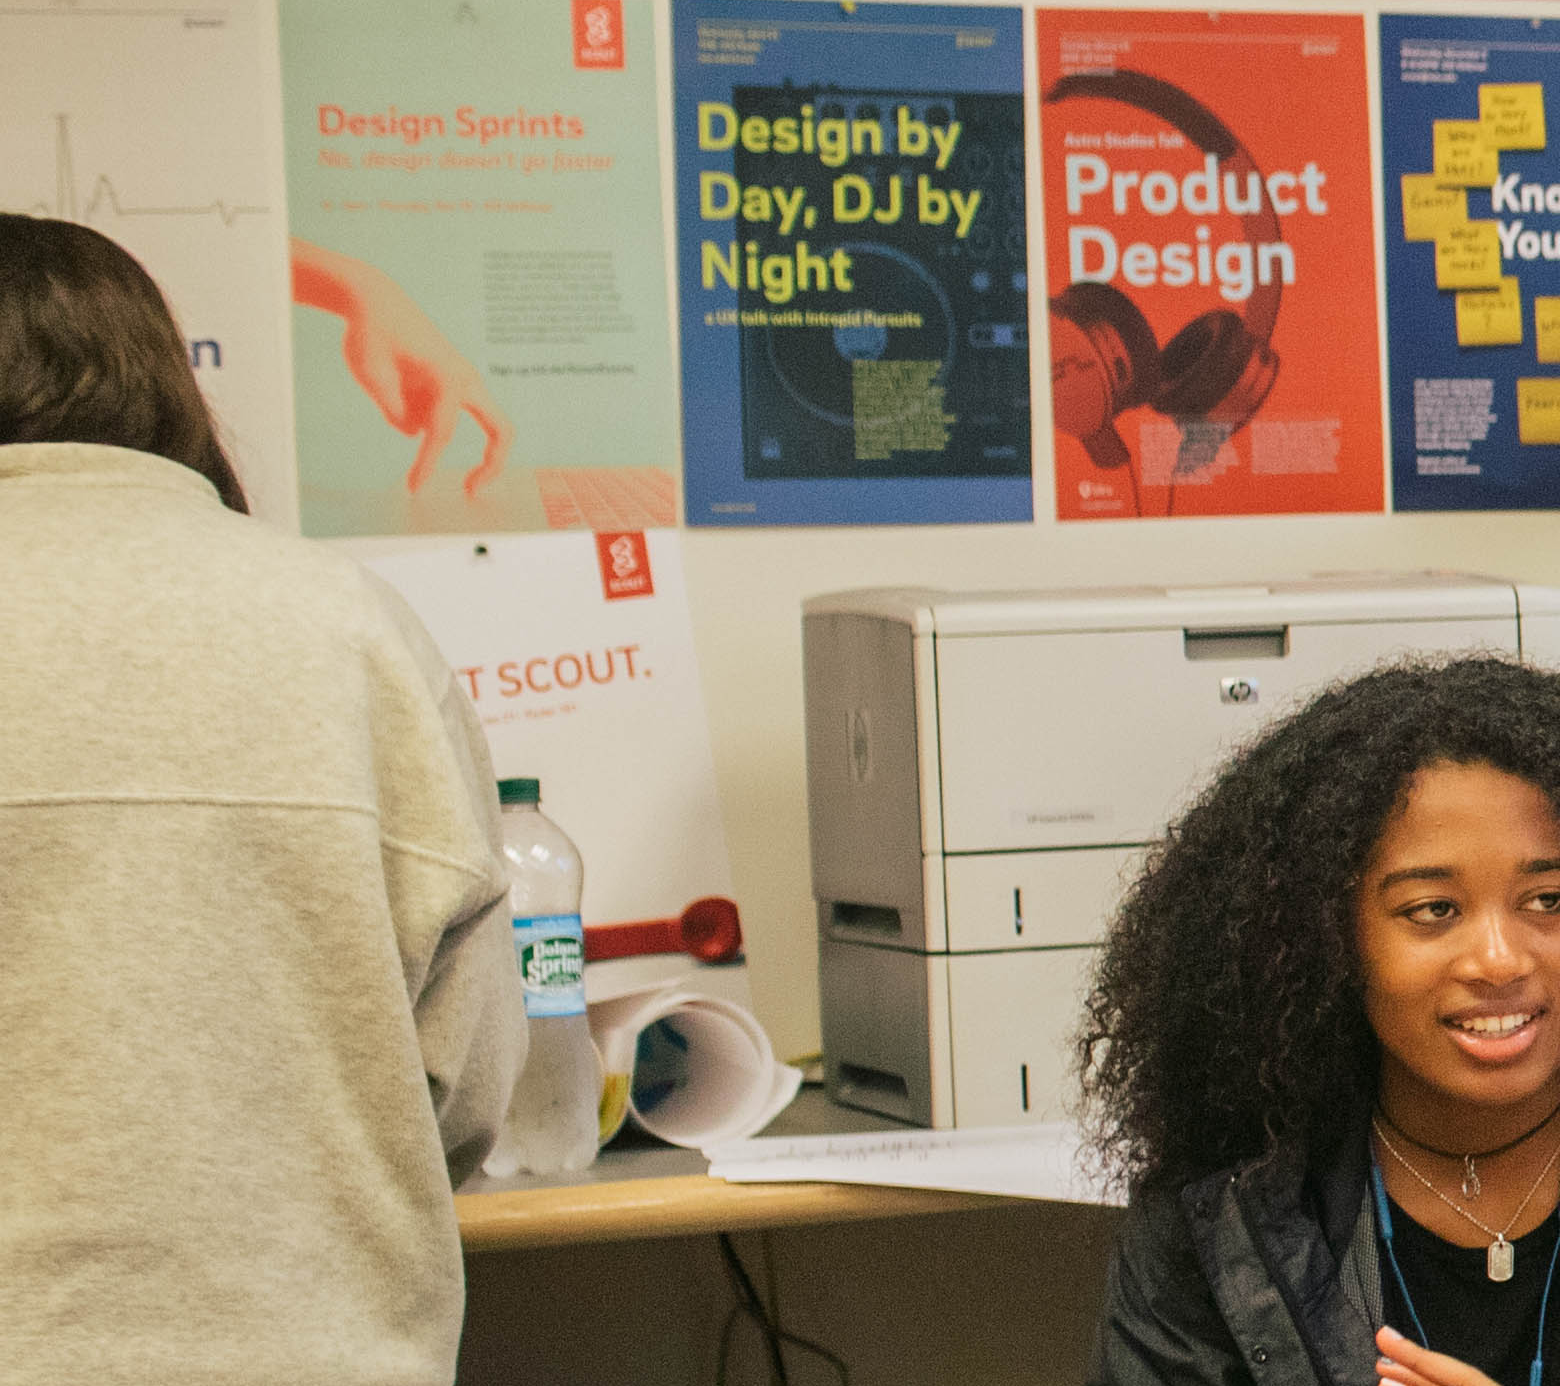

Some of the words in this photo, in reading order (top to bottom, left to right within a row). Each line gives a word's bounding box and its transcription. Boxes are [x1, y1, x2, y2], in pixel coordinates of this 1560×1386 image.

[317, 104, 446, 146] Design
[454, 104, 586, 146] Sprints
[697, 100, 882, 166] Design
[897, 108, 963, 169] by
[361, 149, 432, 173] design
[1065, 152, 1329, 216] Product
[699, 171, 818, 232] Day,
[831, 171, 902, 227] DJ
[916, 177, 981, 237] by
[701, 242, 853, 303] Night
[1069, 226, 1296, 301] Design
[741, 311, 768, 326] talk
[771, 311, 803, 326] with
[496, 644, 653, 699] SCOUT.
